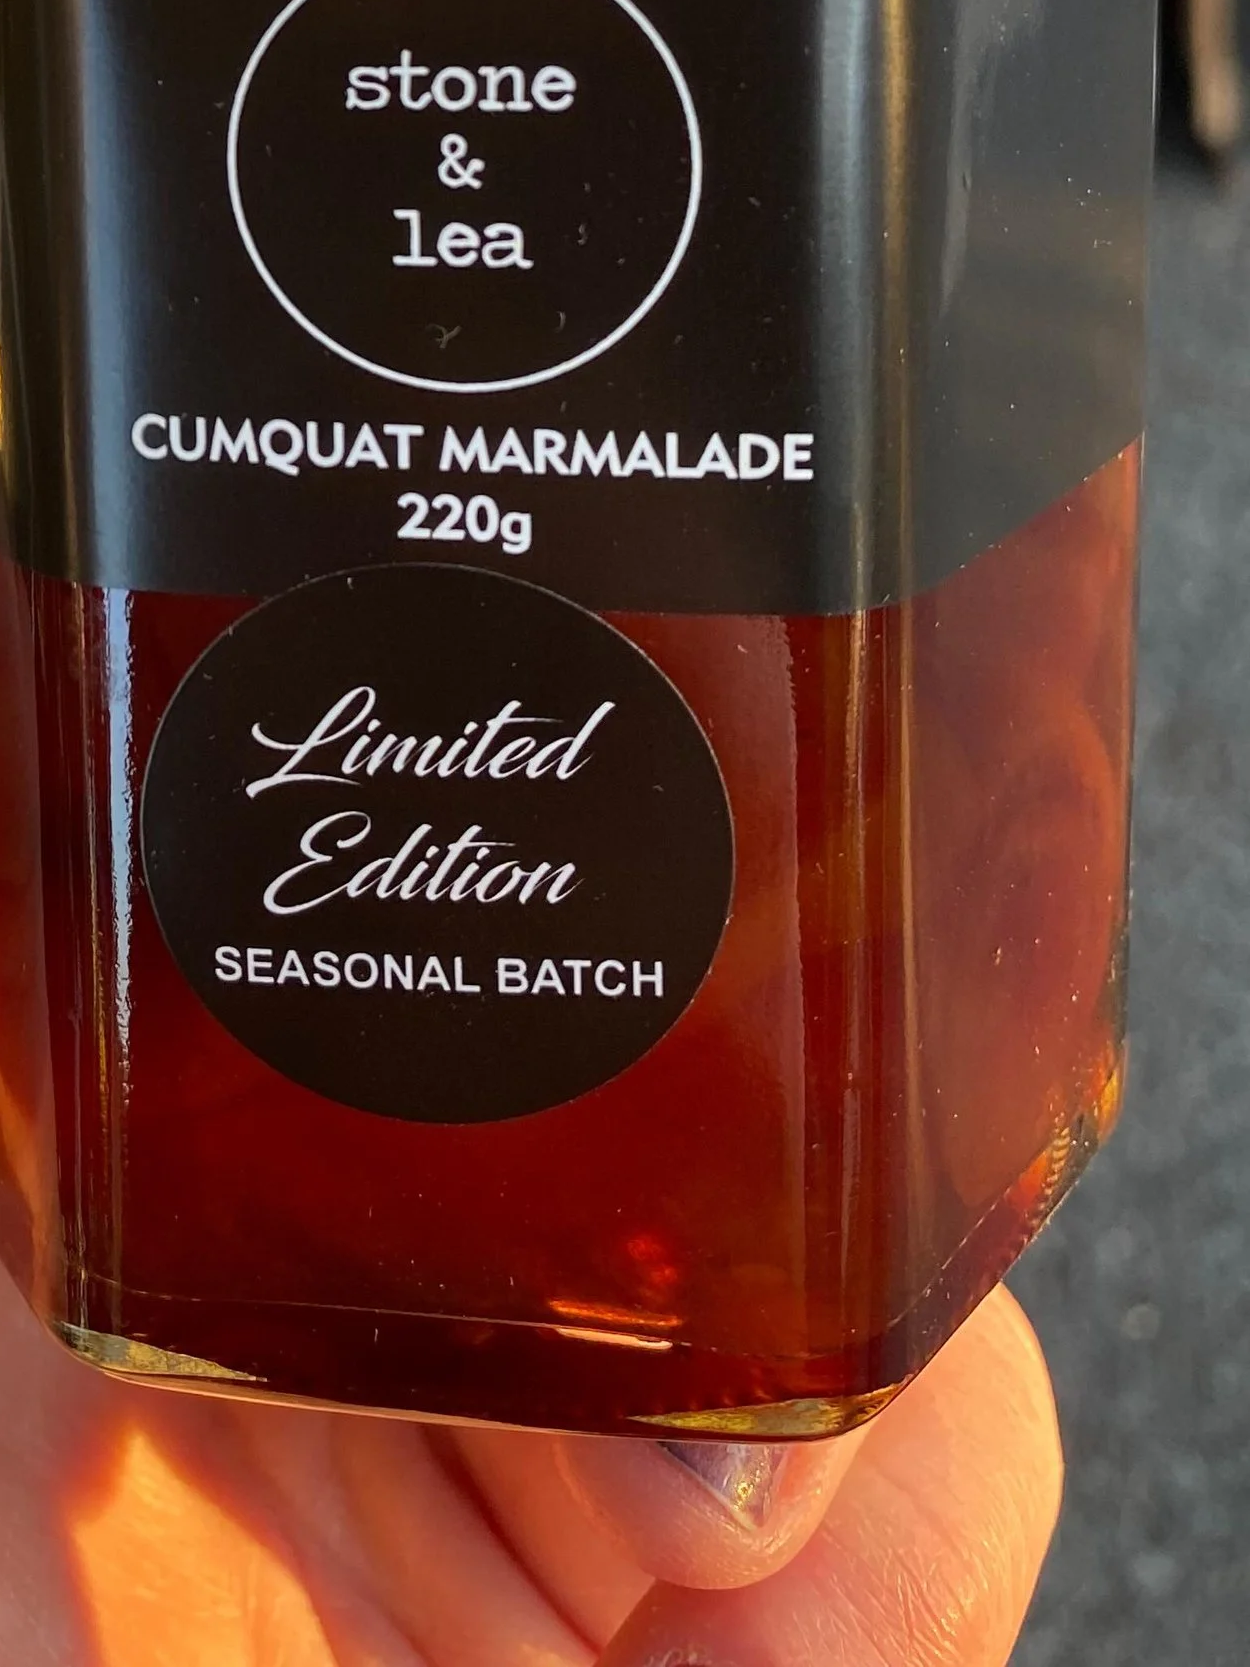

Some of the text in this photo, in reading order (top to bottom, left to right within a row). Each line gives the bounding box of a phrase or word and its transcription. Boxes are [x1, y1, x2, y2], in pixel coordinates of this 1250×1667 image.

[344, 48, 578, 113] stone
[436, 132, 486, 191] &
[391, 208, 535, 270] lea
[130, 412, 815, 482] CUMQUAT MARMALADE
[396, 491, 533, 556] 220g
[244, 684, 617, 799] Limited
[262, 809, 584, 916] Edition
[213, 944, 665, 998] SEASONAL BATCH
